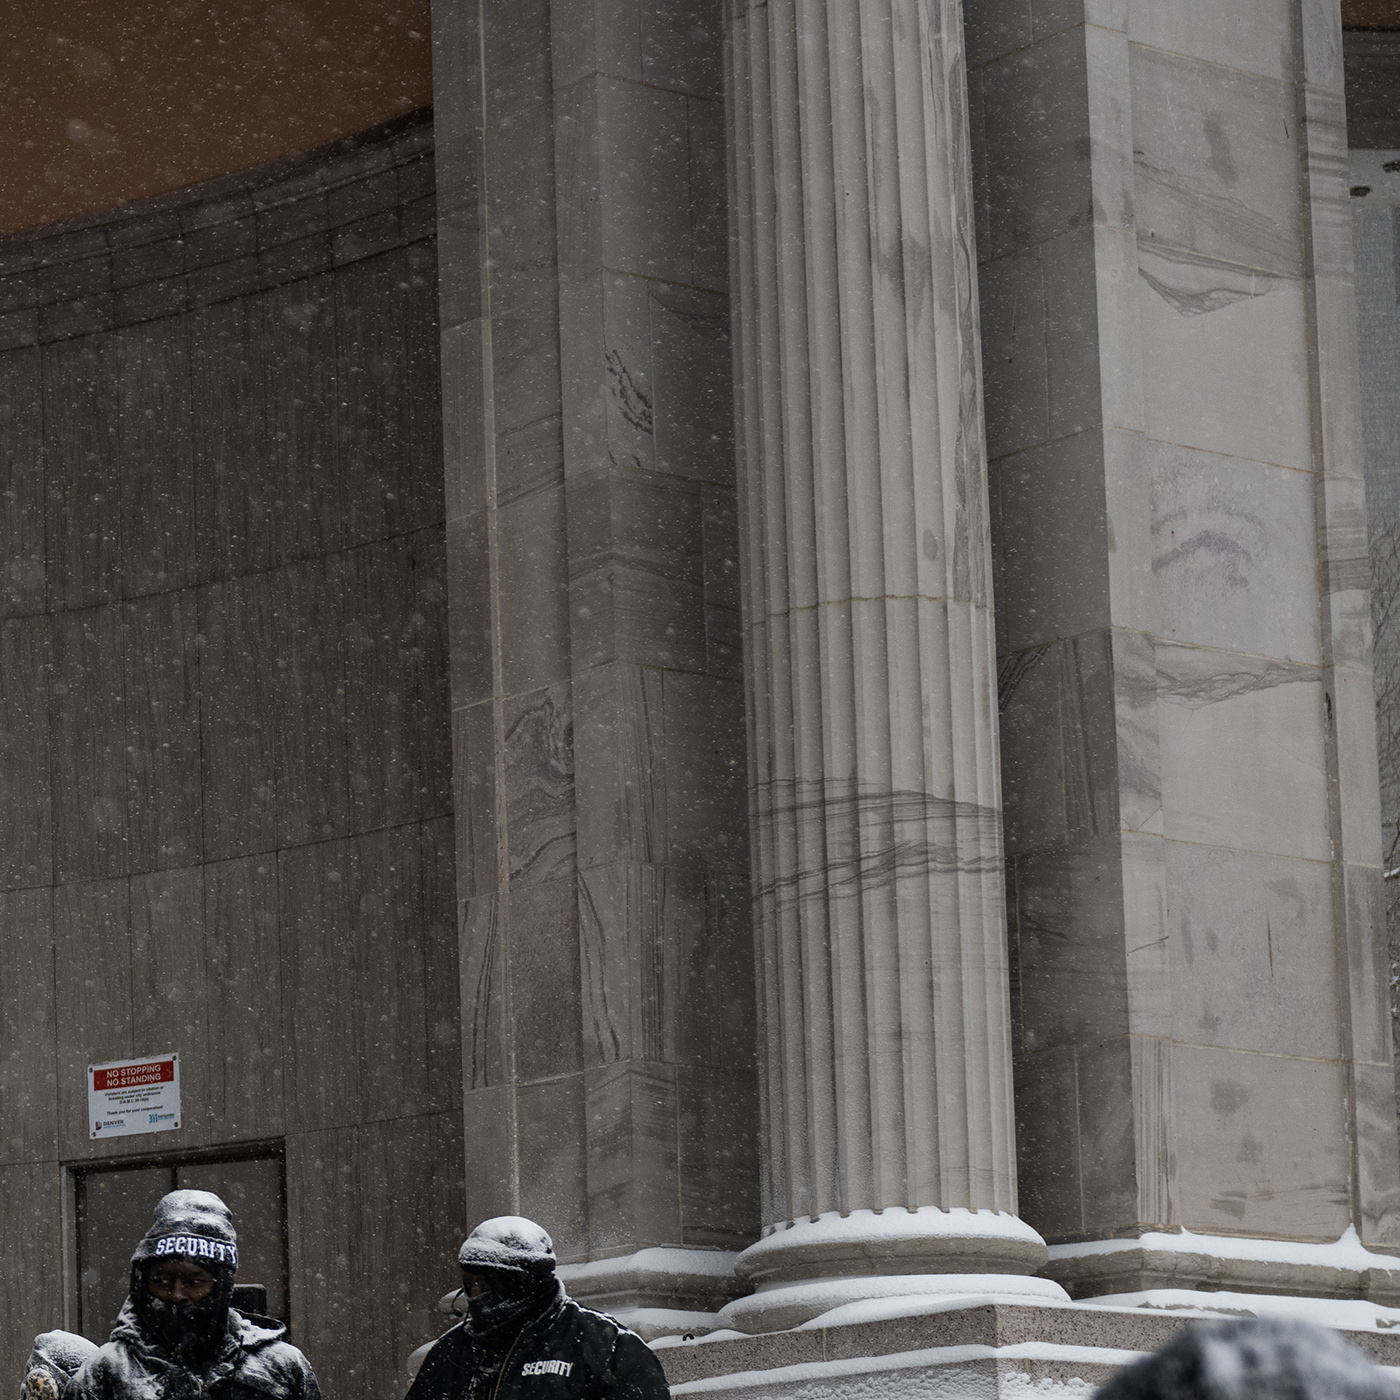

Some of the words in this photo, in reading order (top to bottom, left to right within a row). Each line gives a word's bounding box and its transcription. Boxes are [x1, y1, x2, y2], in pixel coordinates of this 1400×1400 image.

[106, 1070, 119, 1078] NO
[120, 1064, 161, 1077] STOPPING
[106, 1078, 119, 1087] NO
[120, 1073, 161, 1085] STANDING
[148, 1113, 158, 1124] 311
[155, 1236, 237, 1264] SECURITY
[522, 1360, 573, 1377] SECURITY
